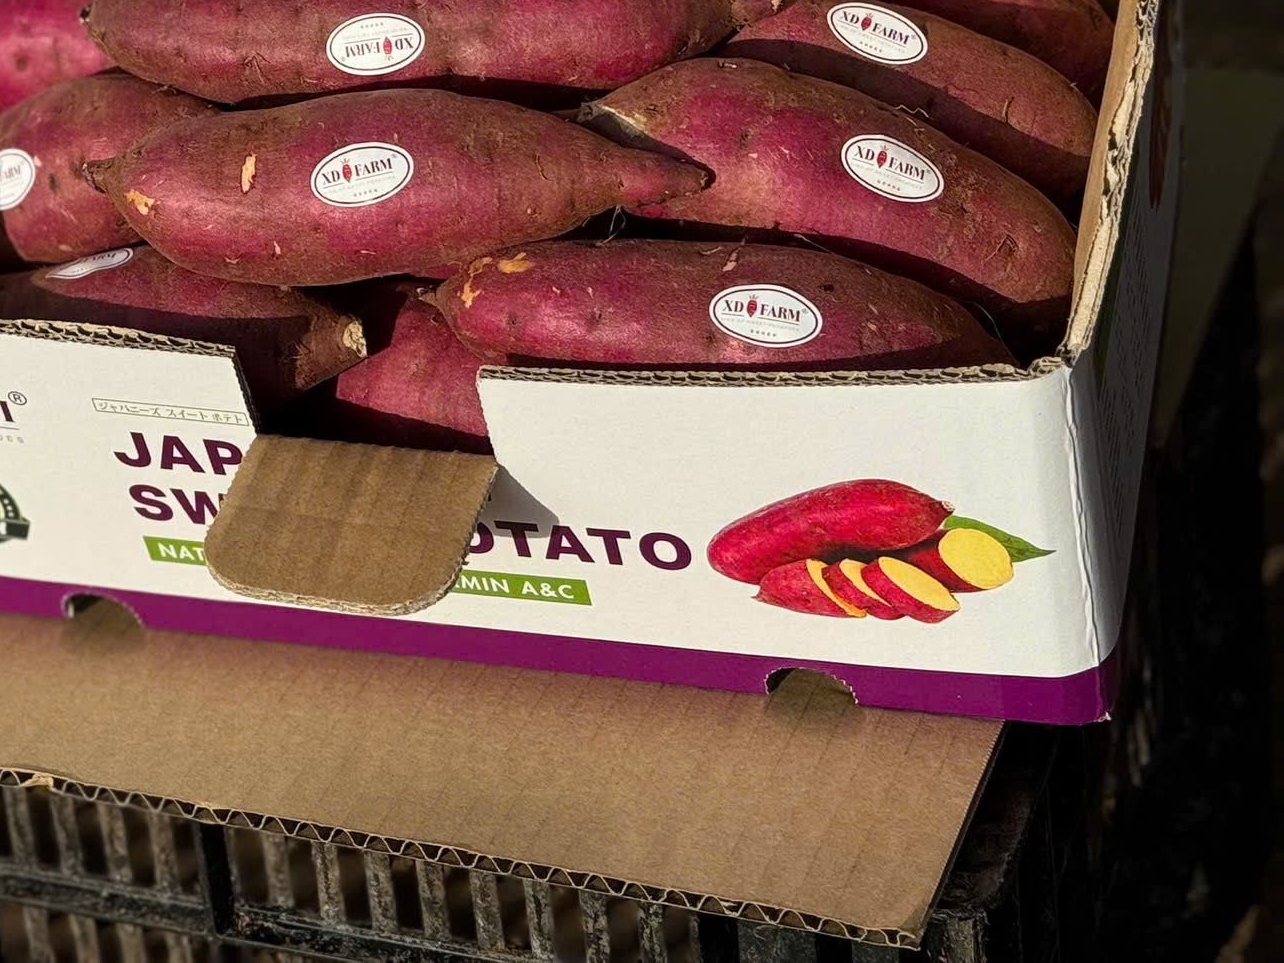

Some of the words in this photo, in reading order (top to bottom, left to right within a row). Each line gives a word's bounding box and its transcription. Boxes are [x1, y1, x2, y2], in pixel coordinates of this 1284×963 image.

[839, 9, 860, 26] XD
[872, 22, 910, 46] FARM
[344, 43, 381, 59] FARM
[395, 37, 415, 51] XD
[321, 168, 341, 186] XD
[354, 157, 394, 178] FARM
[853, 145, 875, 162] XD
[888, 156, 926, 181] FARM
[721, 299, 745, 314] XD
[759, 303, 801, 323] FARM
[113, 431, 244, 476] JAP
[128, 483, 225, 526] SW
[521, 580, 575, 600] A&C
